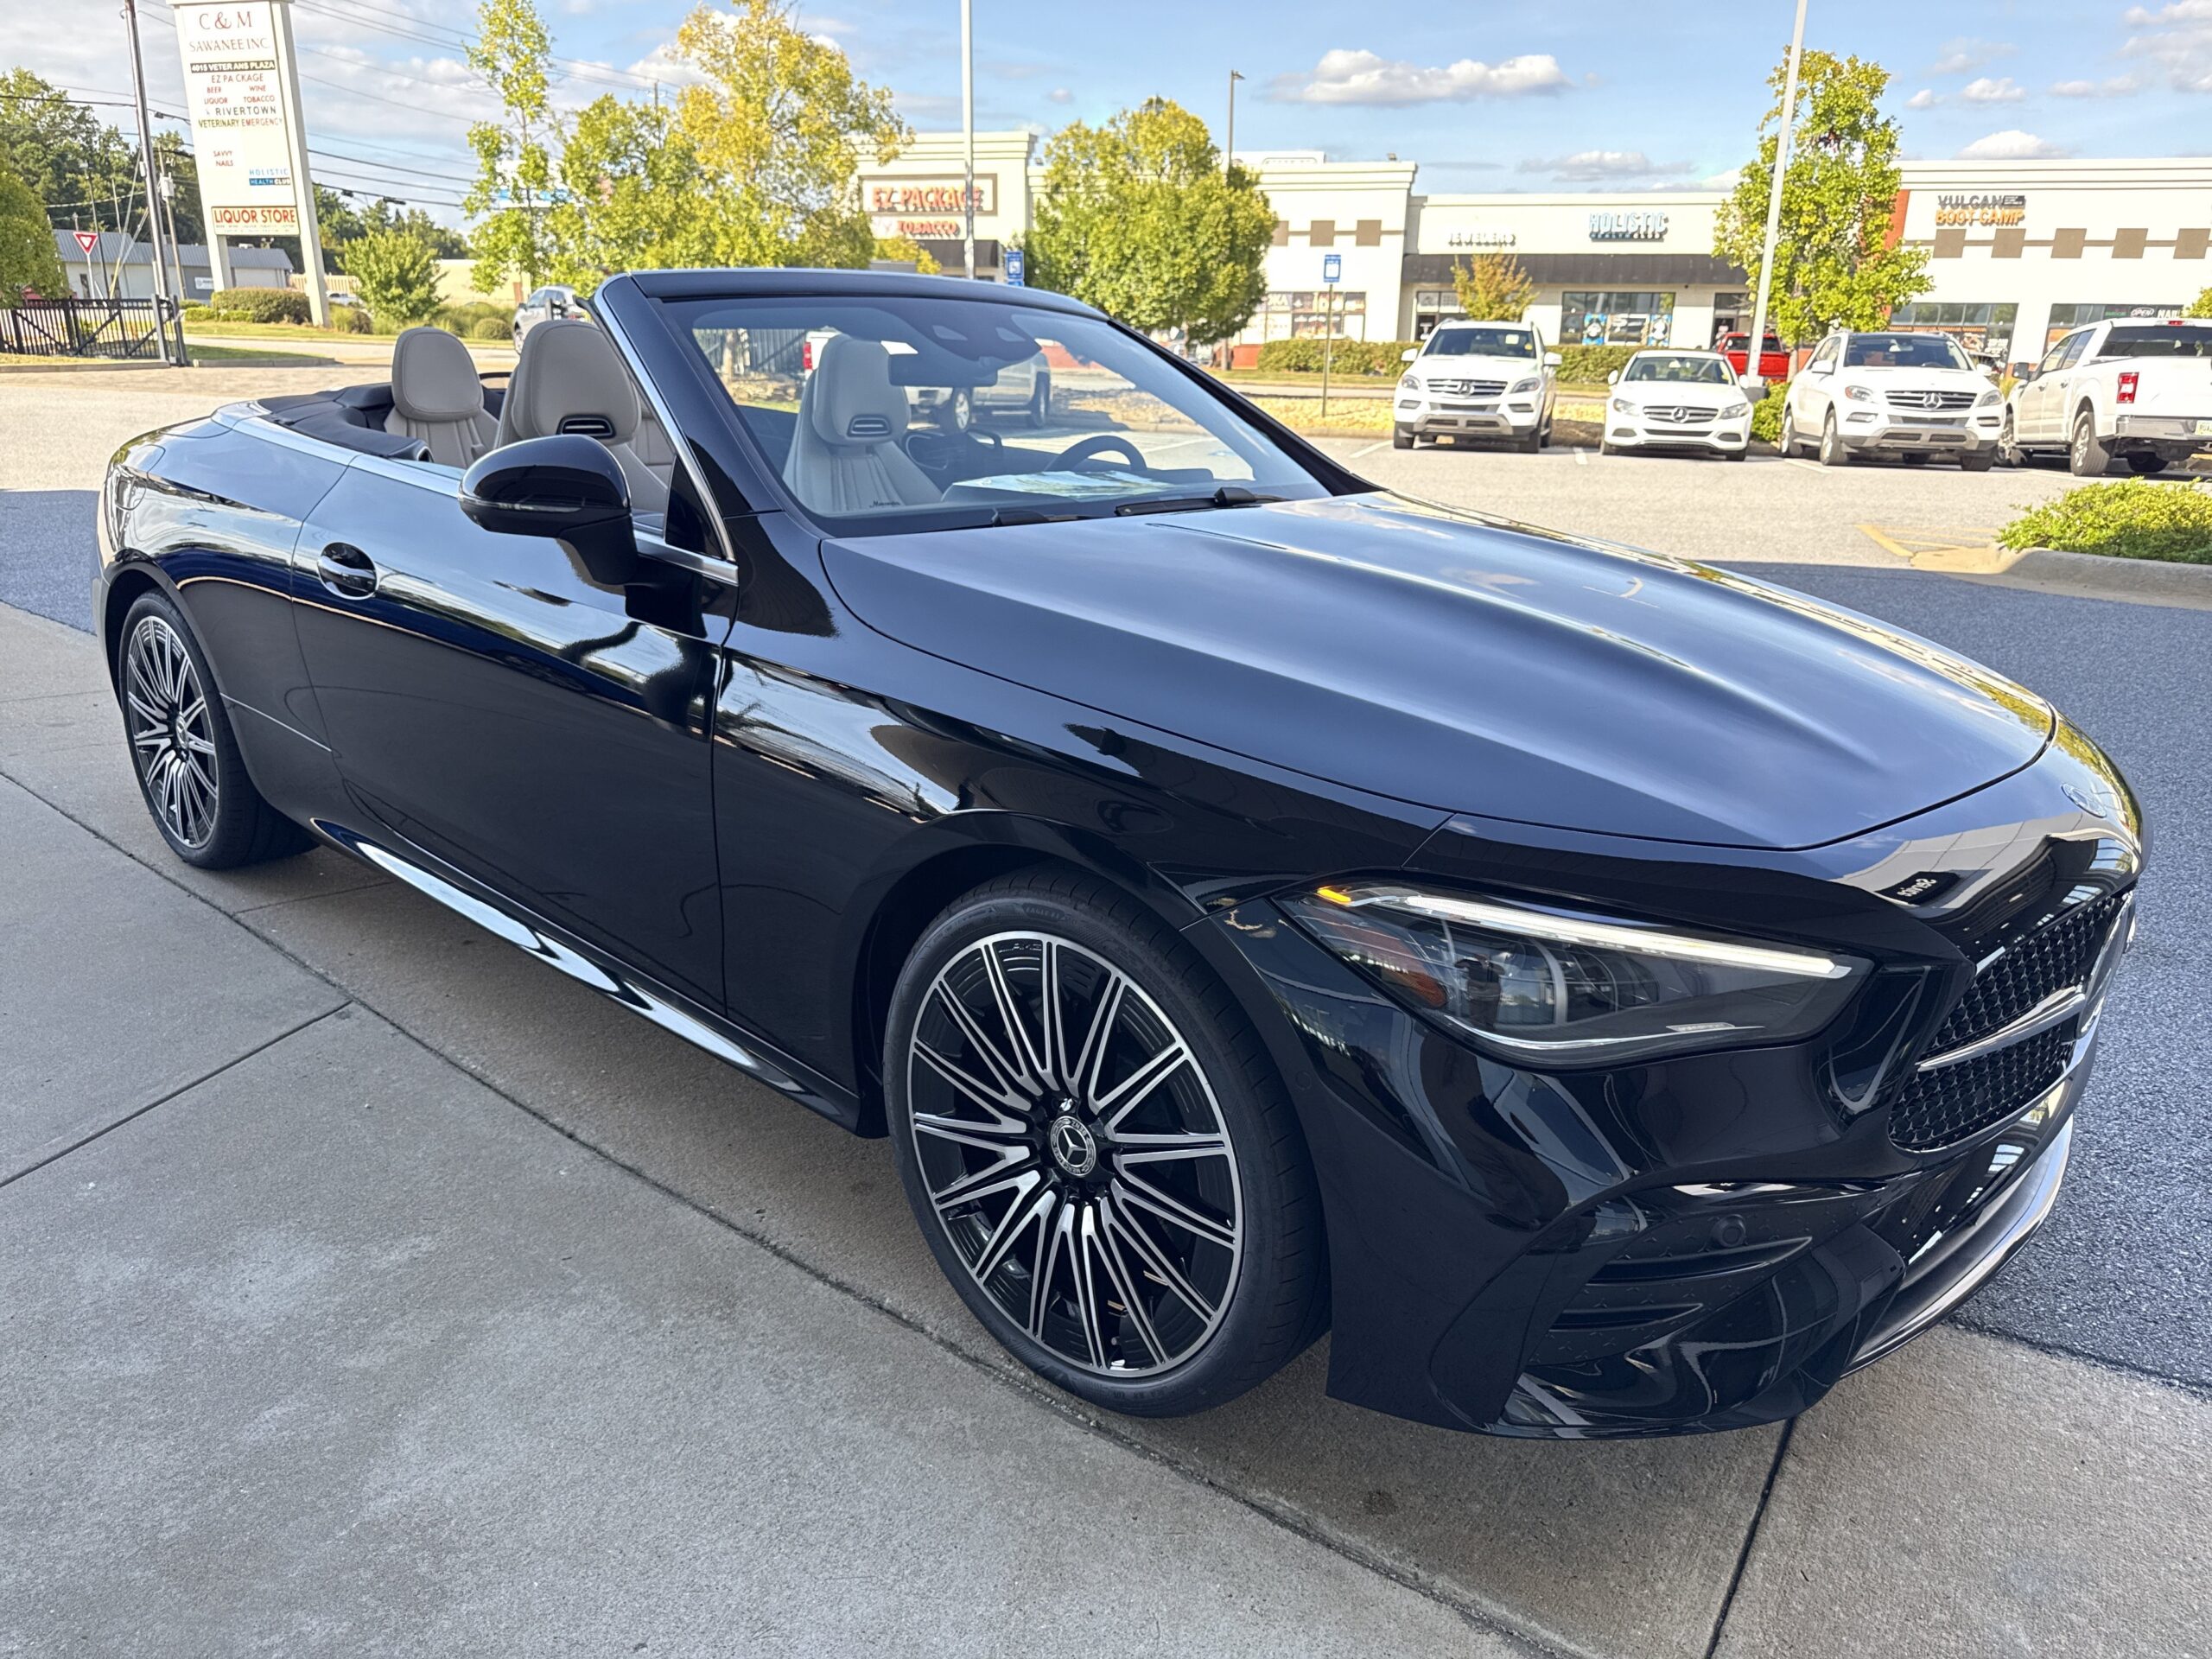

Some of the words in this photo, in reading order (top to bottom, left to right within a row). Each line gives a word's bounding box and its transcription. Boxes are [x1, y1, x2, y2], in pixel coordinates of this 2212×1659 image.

[200, 13, 211, 30] C
[214, 11, 232, 29] &
[237, 11, 251, 28] M
[188, 39, 245, 52] SAWANEE
[191, 63, 208, 72] 4015
[250, 60, 275, 70] PLAZA
[211, 74, 221, 84] EZ
[215, 106, 276, 116] RIVERTOWN
[198, 119, 239, 128] VETERINARY
[241, 118, 283, 127] EMERGENCY
[249, 168, 289, 176] HOLISTIC
[873, 186, 895, 210] EZ
[1937, 194, 2002, 209] VULCAN
[214, 209, 257, 224] LIQUOR
[261, 209, 296, 224] STORE
[1589, 212, 1669, 234] HOLISTIC
[1935, 209, 1975, 226] BOOT
[1979, 208, 2025, 226] CAMP
[898, 219, 960, 236] TOBACCO
